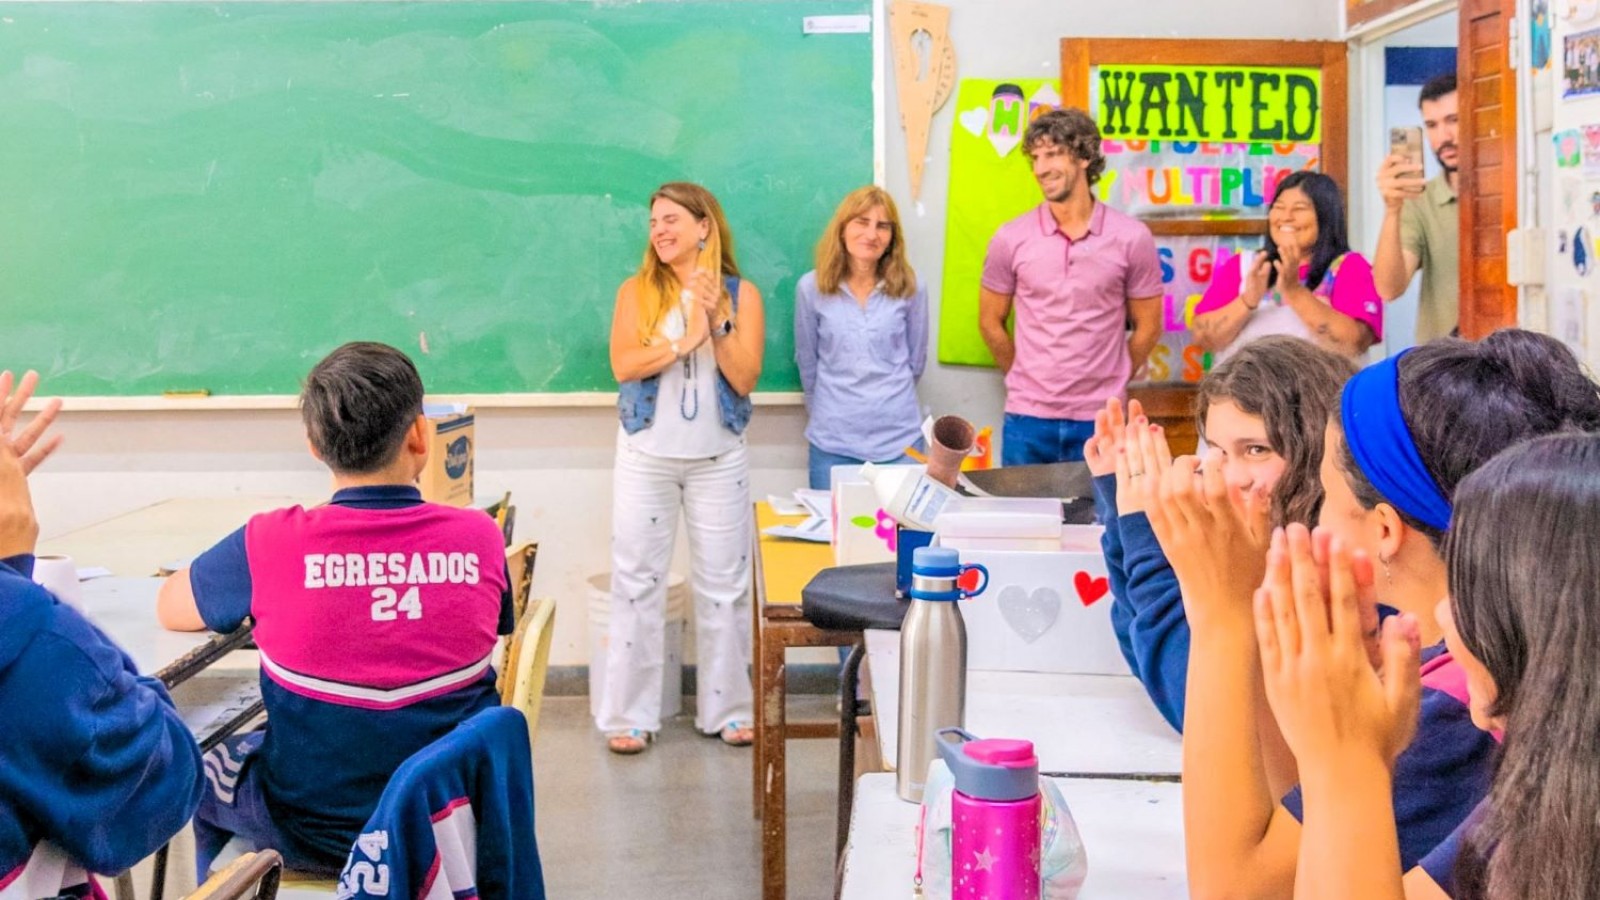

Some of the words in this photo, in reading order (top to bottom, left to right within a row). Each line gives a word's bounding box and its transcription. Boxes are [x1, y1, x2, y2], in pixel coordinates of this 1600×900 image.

[1100, 71, 1319, 141] WANTED
[1122, 164, 1294, 207] MULTIPLI
[304, 552, 480, 589] EGRESADOS
[371, 586, 422, 621] 24
[350, 829, 390, 896] 24
